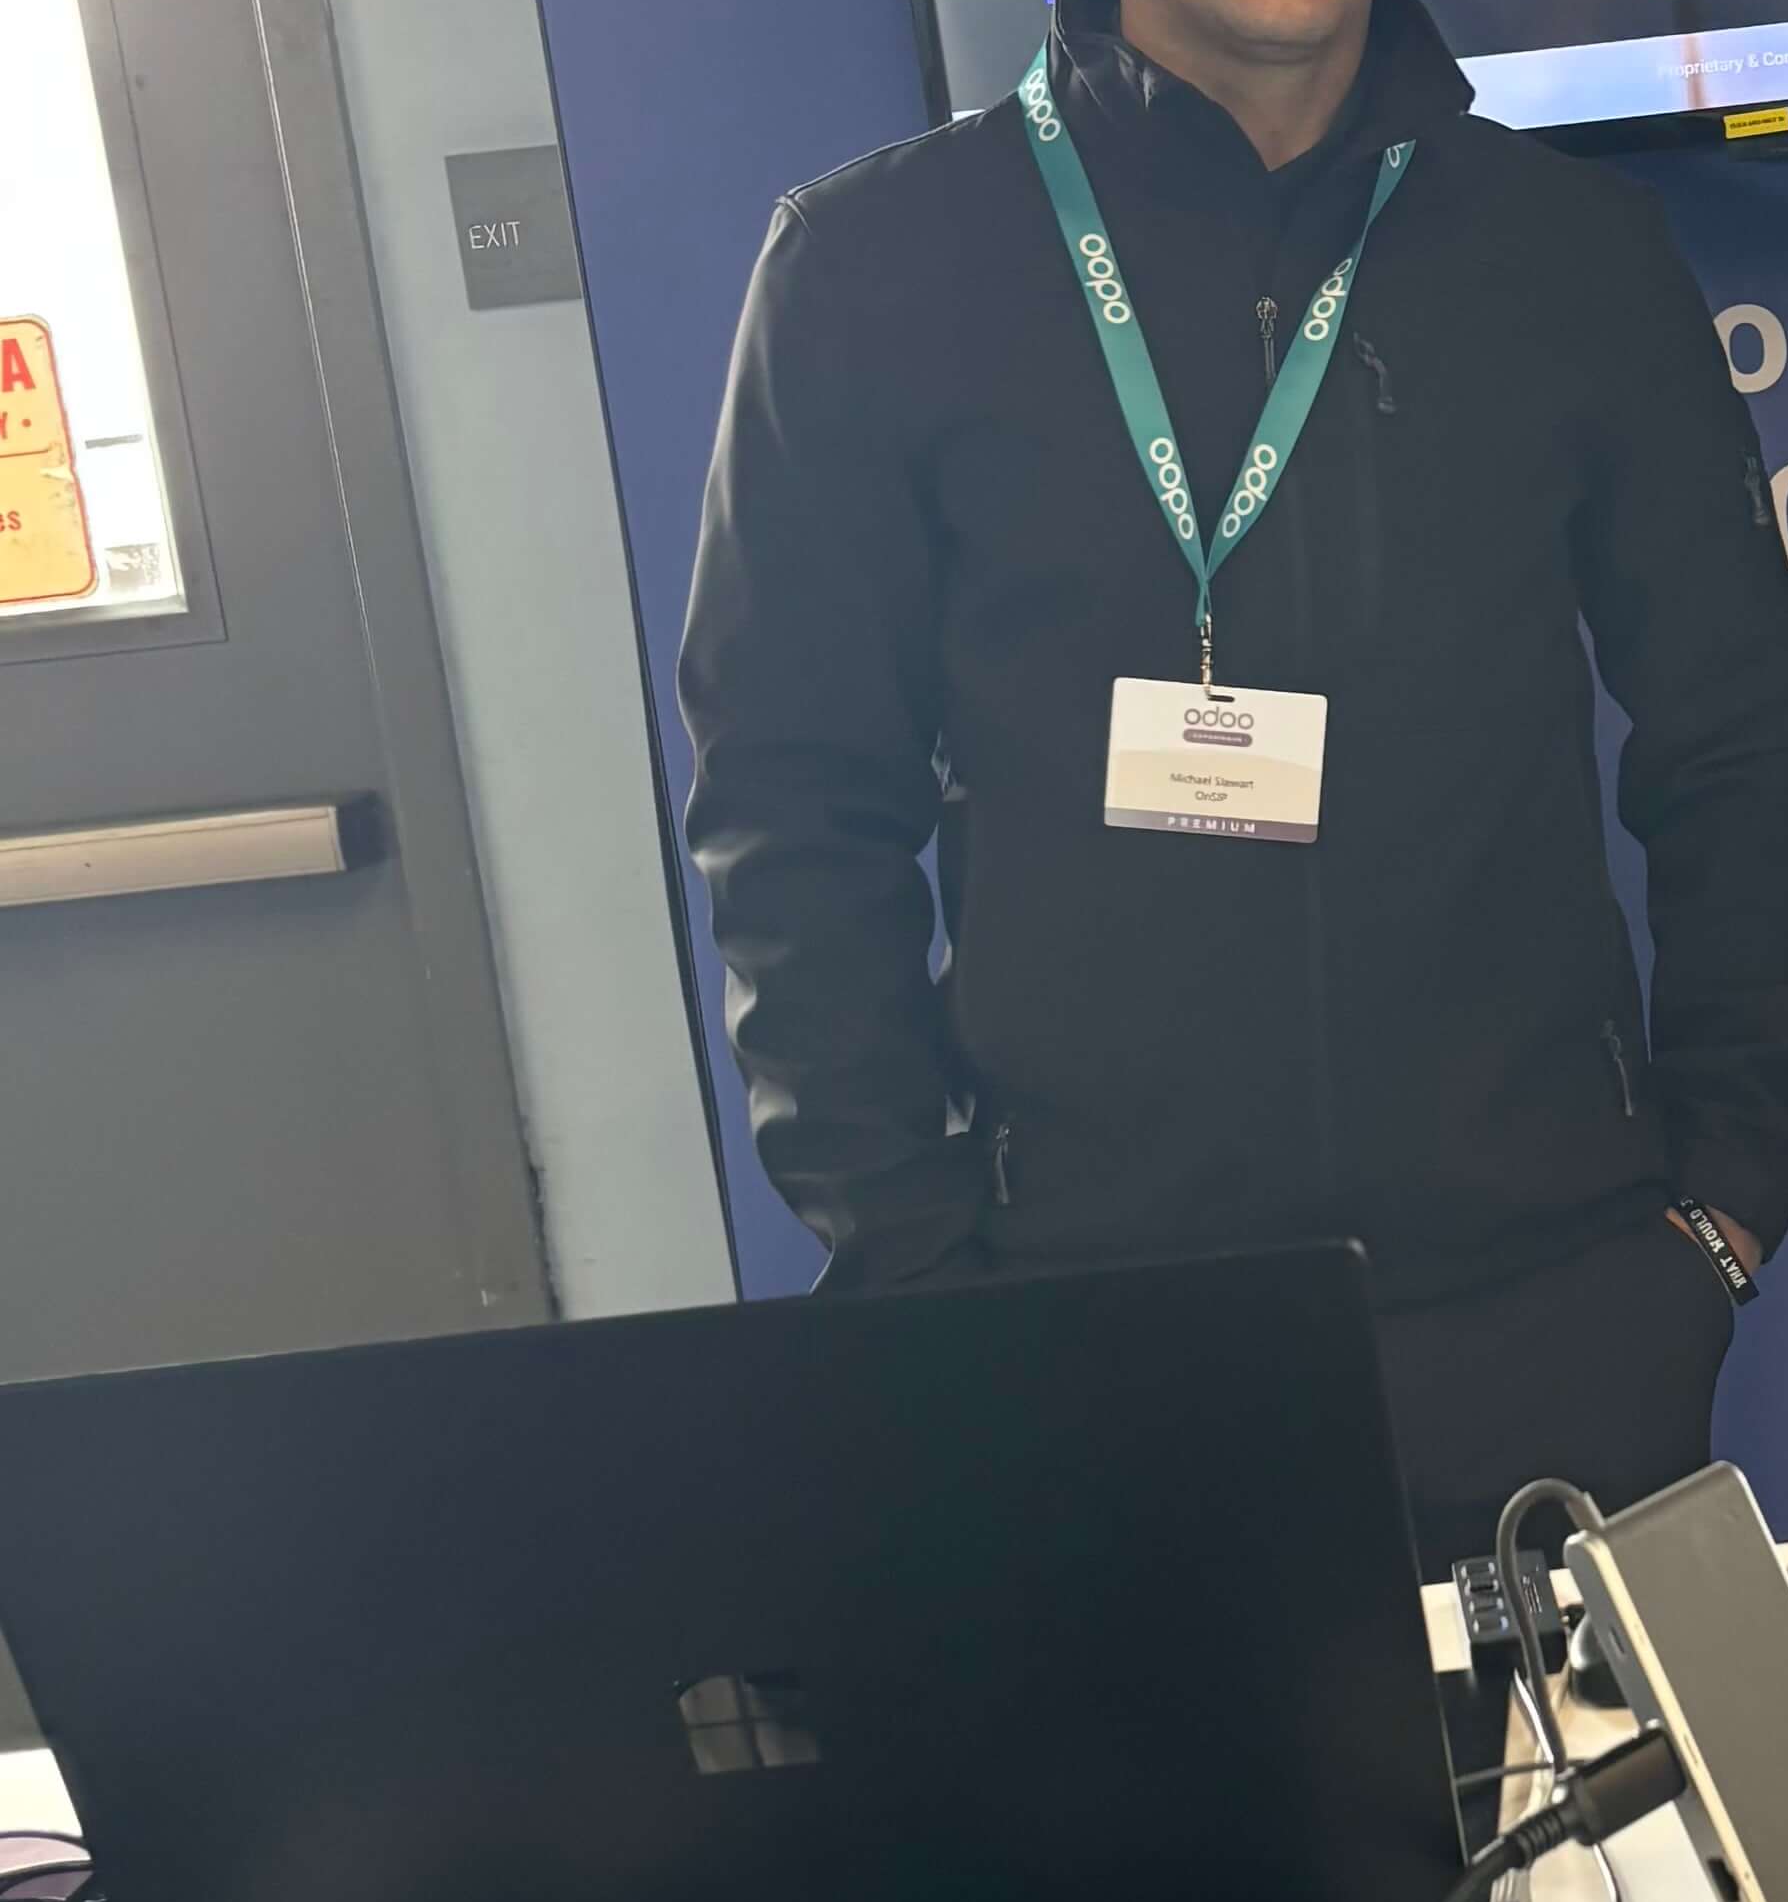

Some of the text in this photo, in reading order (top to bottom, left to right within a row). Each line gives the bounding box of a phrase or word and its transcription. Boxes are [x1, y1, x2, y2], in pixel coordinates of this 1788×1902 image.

[1657, 57, 1744, 78] Proprietary
[1749, 53, 1760, 68] &
[467, 220, 521, 250] EXIT
[1184, 706, 1254, 730] odoo
[1167, 816, 1256, 834] PREMIUM
[1689, 1208, 1748, 1289] WHAT WOULD
